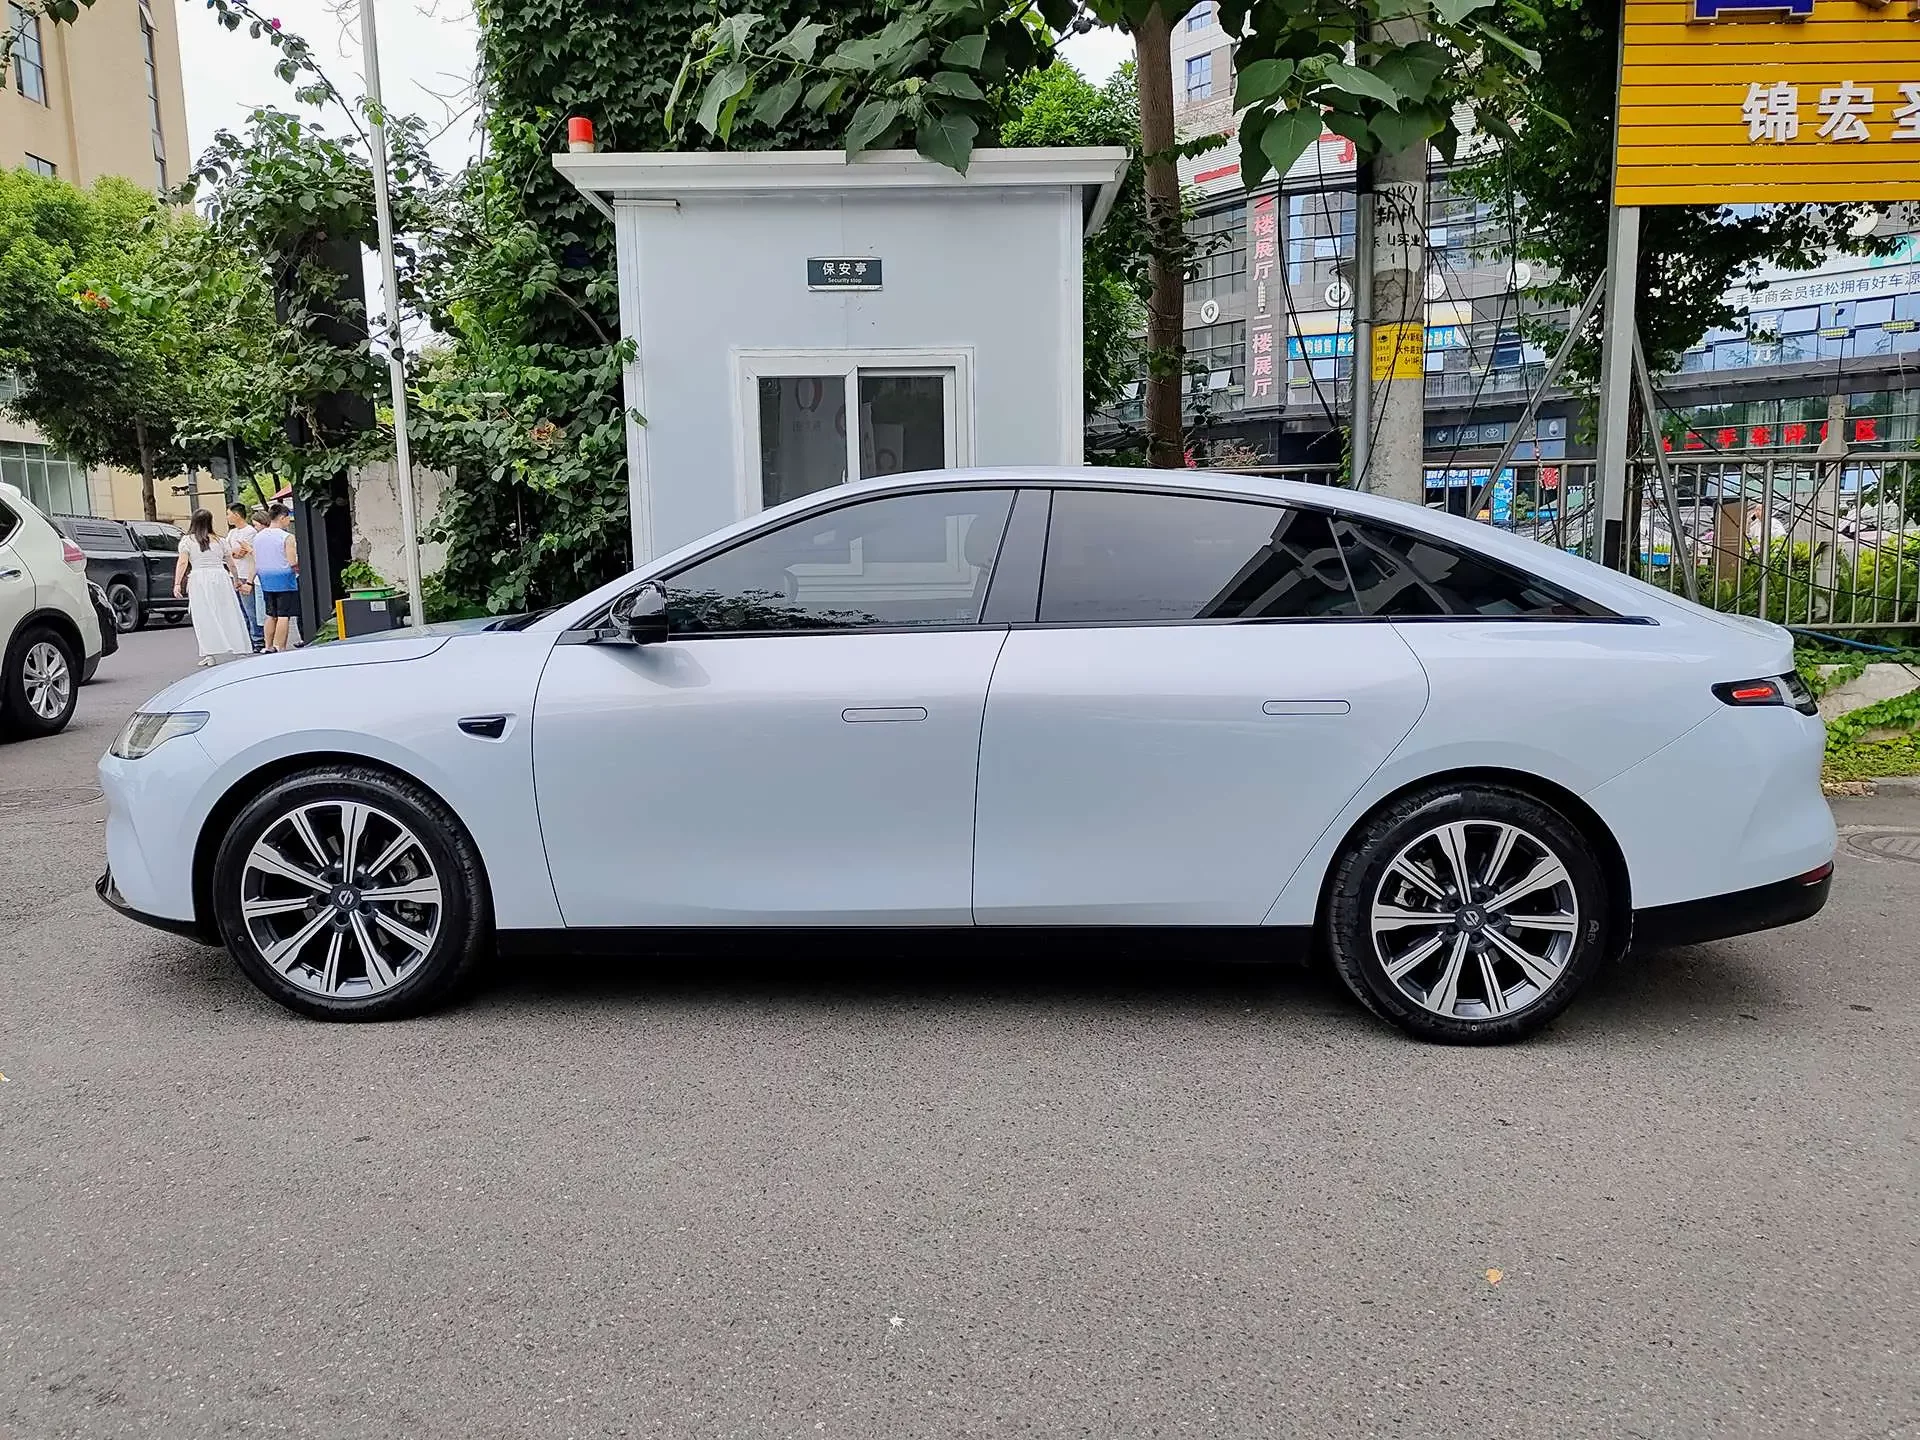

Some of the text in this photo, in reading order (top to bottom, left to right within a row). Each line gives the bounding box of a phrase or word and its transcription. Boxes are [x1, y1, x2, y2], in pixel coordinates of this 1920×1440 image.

[823, 262, 867, 276] 保安亭
[1252, 314, 1274, 397] 二楼展厅
[1663, 419, 1877, 452] 二手车评区
